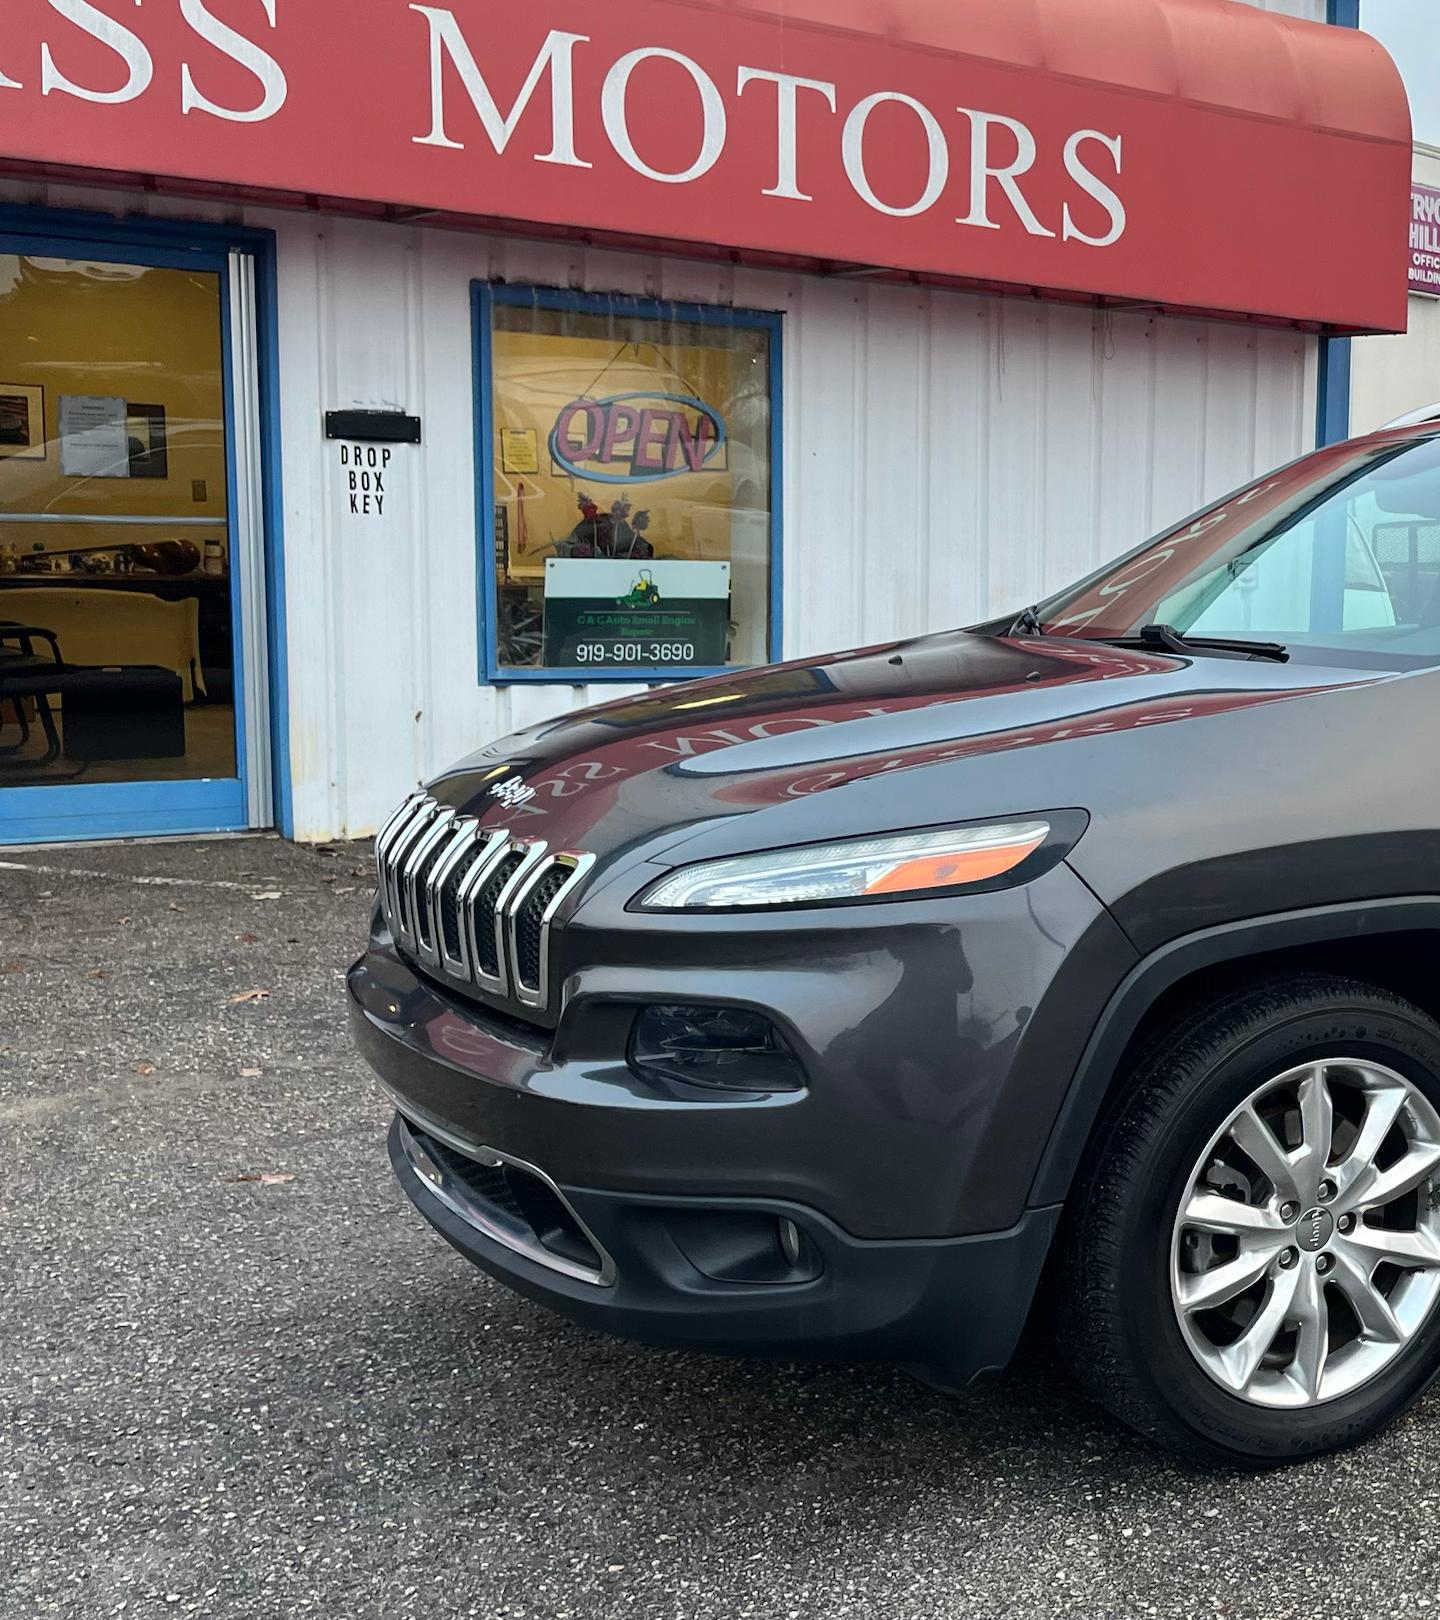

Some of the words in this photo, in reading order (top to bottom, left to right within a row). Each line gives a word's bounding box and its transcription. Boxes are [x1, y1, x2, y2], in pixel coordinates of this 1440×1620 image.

[0, 0, 288, 123] SS
[409, 3, 1126, 247] MOTORS
[557, 399, 713, 473] OPEN
[341, 445, 391, 468] DROP
[349, 470, 384, 492] BOX
[350, 493, 383, 515] KEY
[576, 643, 694, 662] 919-901-3690
